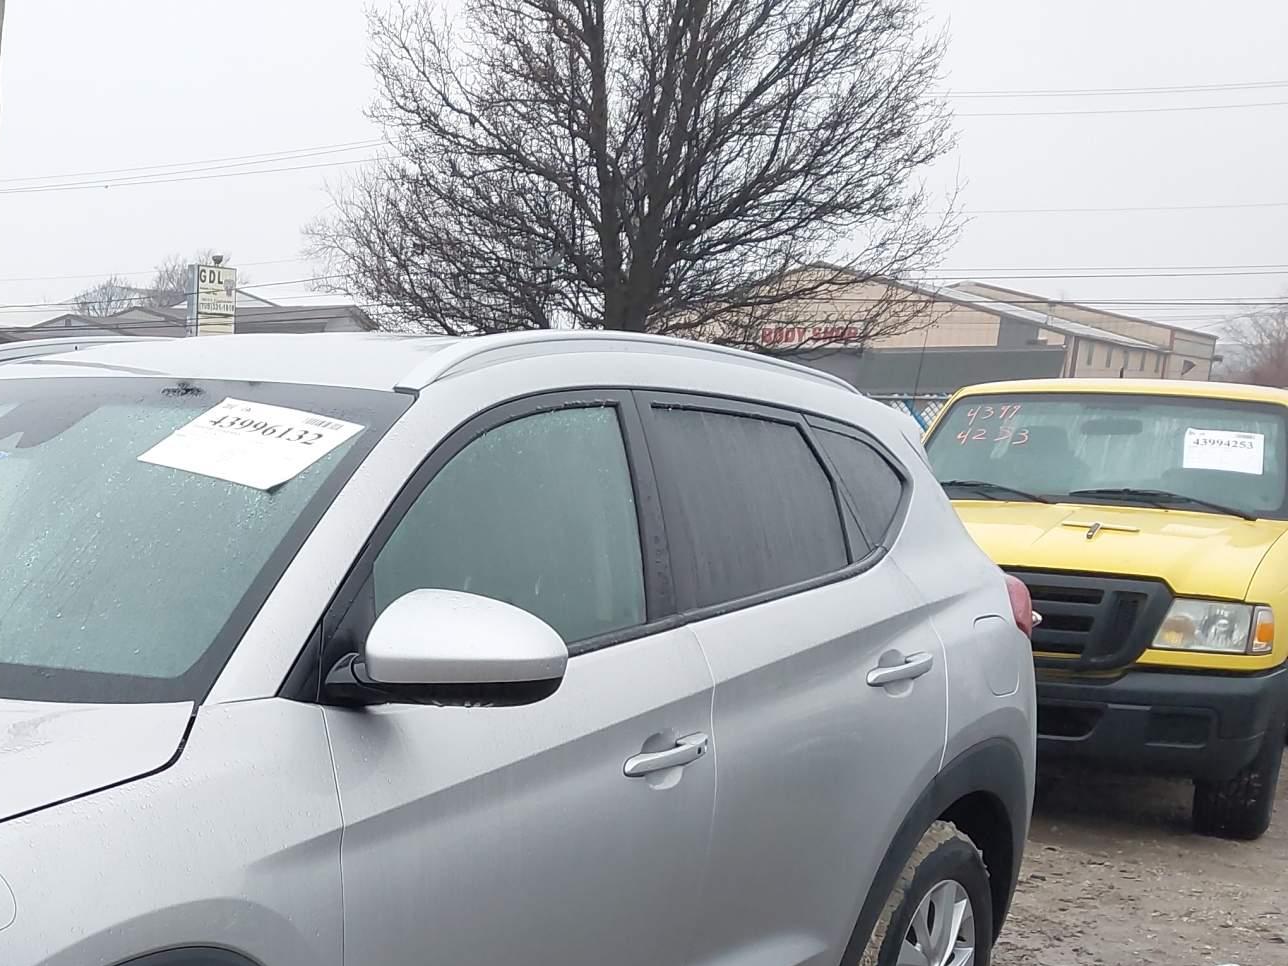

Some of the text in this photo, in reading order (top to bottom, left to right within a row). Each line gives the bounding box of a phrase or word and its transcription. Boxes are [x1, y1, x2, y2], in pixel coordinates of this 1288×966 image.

[199, 269, 223, 284] GDL
[761, 326, 859, 343] BODY SHOP
[210, 416, 323, 445] 43996132
[1193, 438, 1254, 449] 43994253
